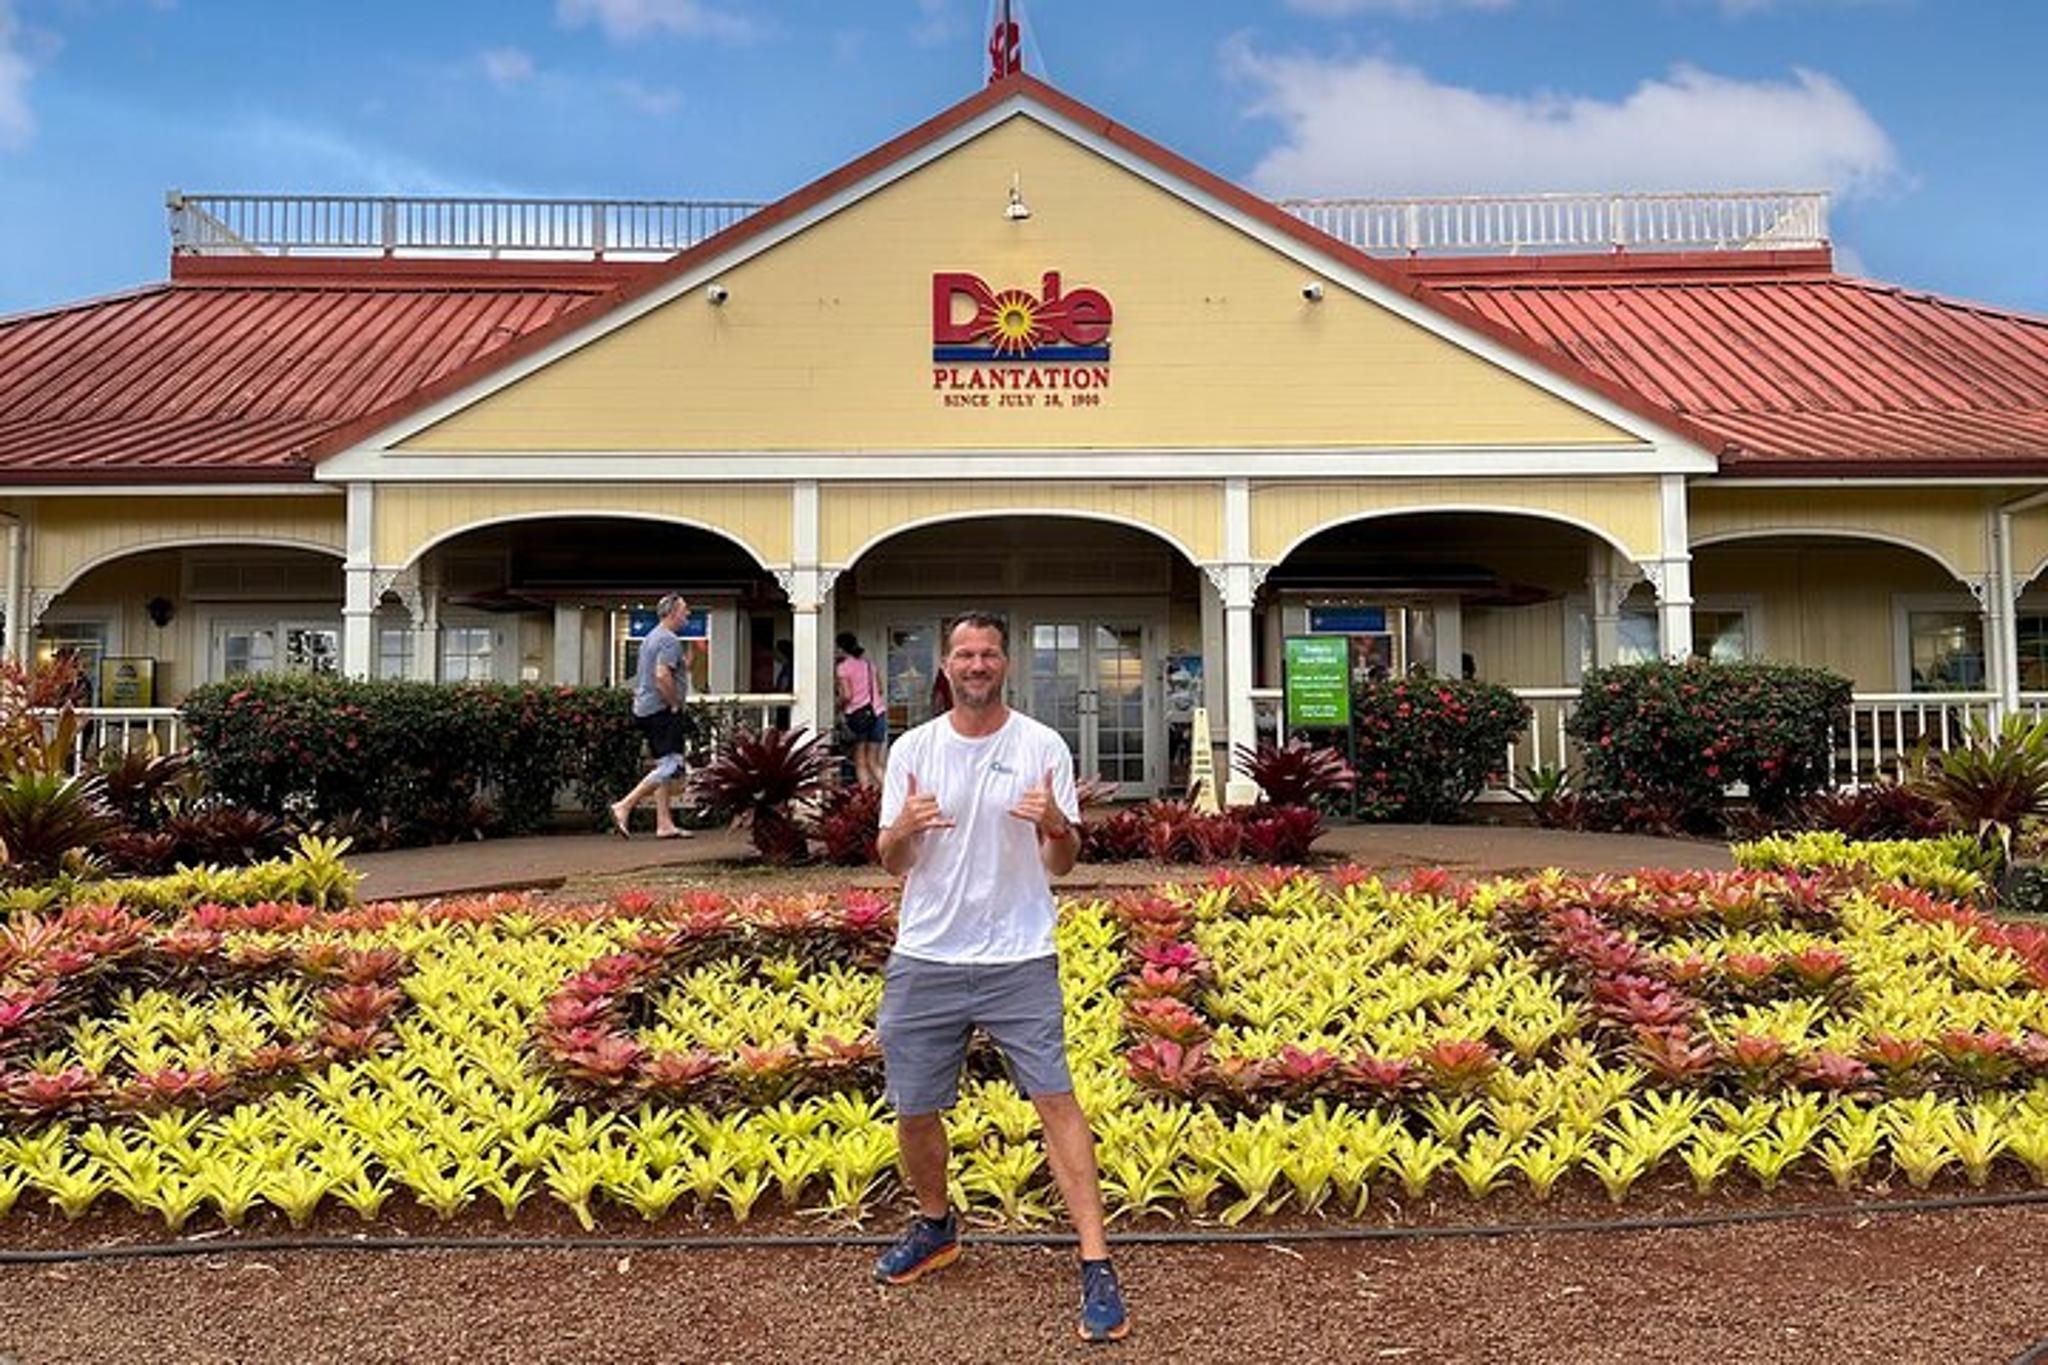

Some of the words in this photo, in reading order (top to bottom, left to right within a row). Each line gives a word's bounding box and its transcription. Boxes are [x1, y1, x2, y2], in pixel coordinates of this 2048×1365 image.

[933, 271, 1113, 346] Dole
[933, 369, 1110, 390] PLANTATION
[944, 394, 989, 407] SINCE
[998, 394, 1036, 407] JULY
